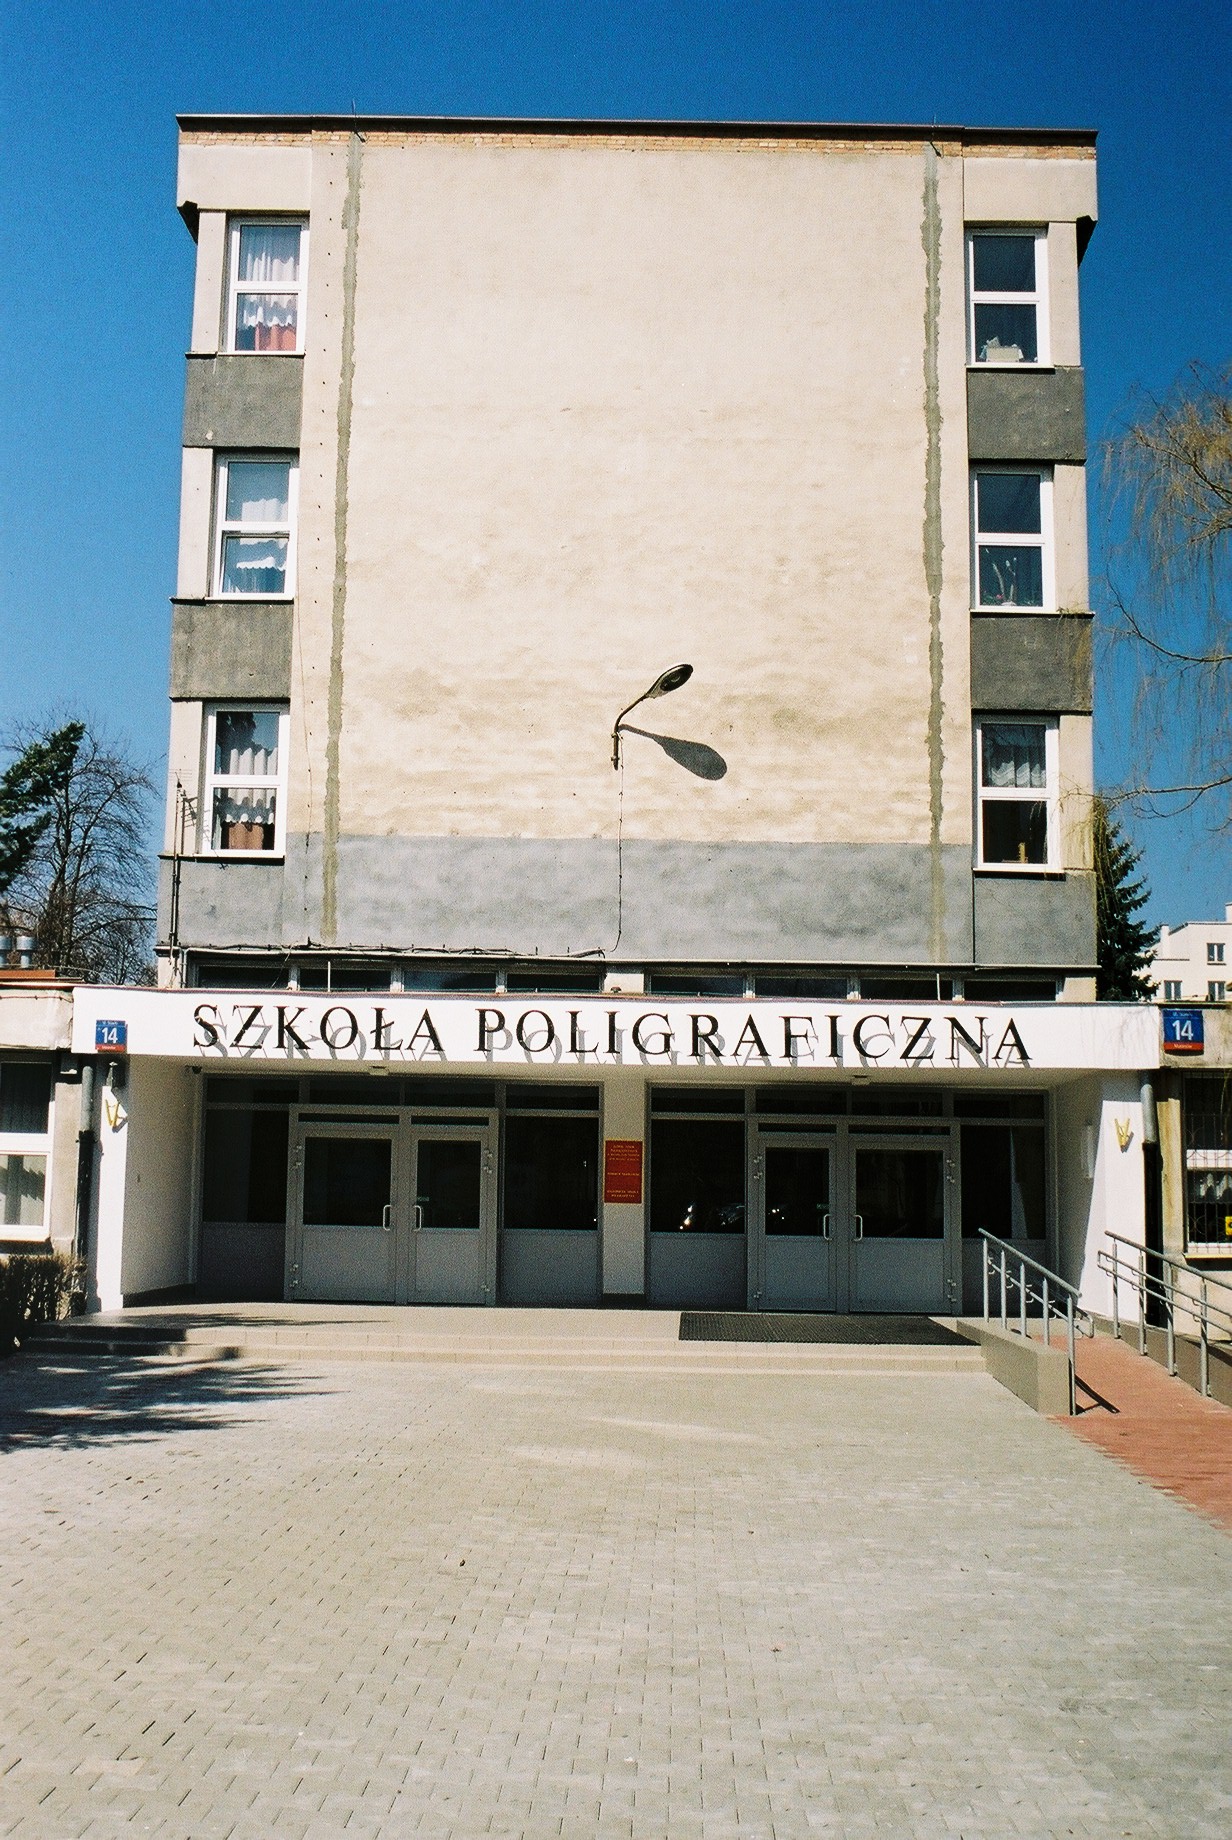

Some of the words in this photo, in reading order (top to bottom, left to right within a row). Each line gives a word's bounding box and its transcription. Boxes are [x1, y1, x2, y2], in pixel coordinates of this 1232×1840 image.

[102, 1027, 118, 1044] 14
[193, 1003, 444, 1052] SZKOŁA
[474, 1007, 1033, 1061] POLIGRAFICZNA
[1172, 1020, 1193, 1041] 14
